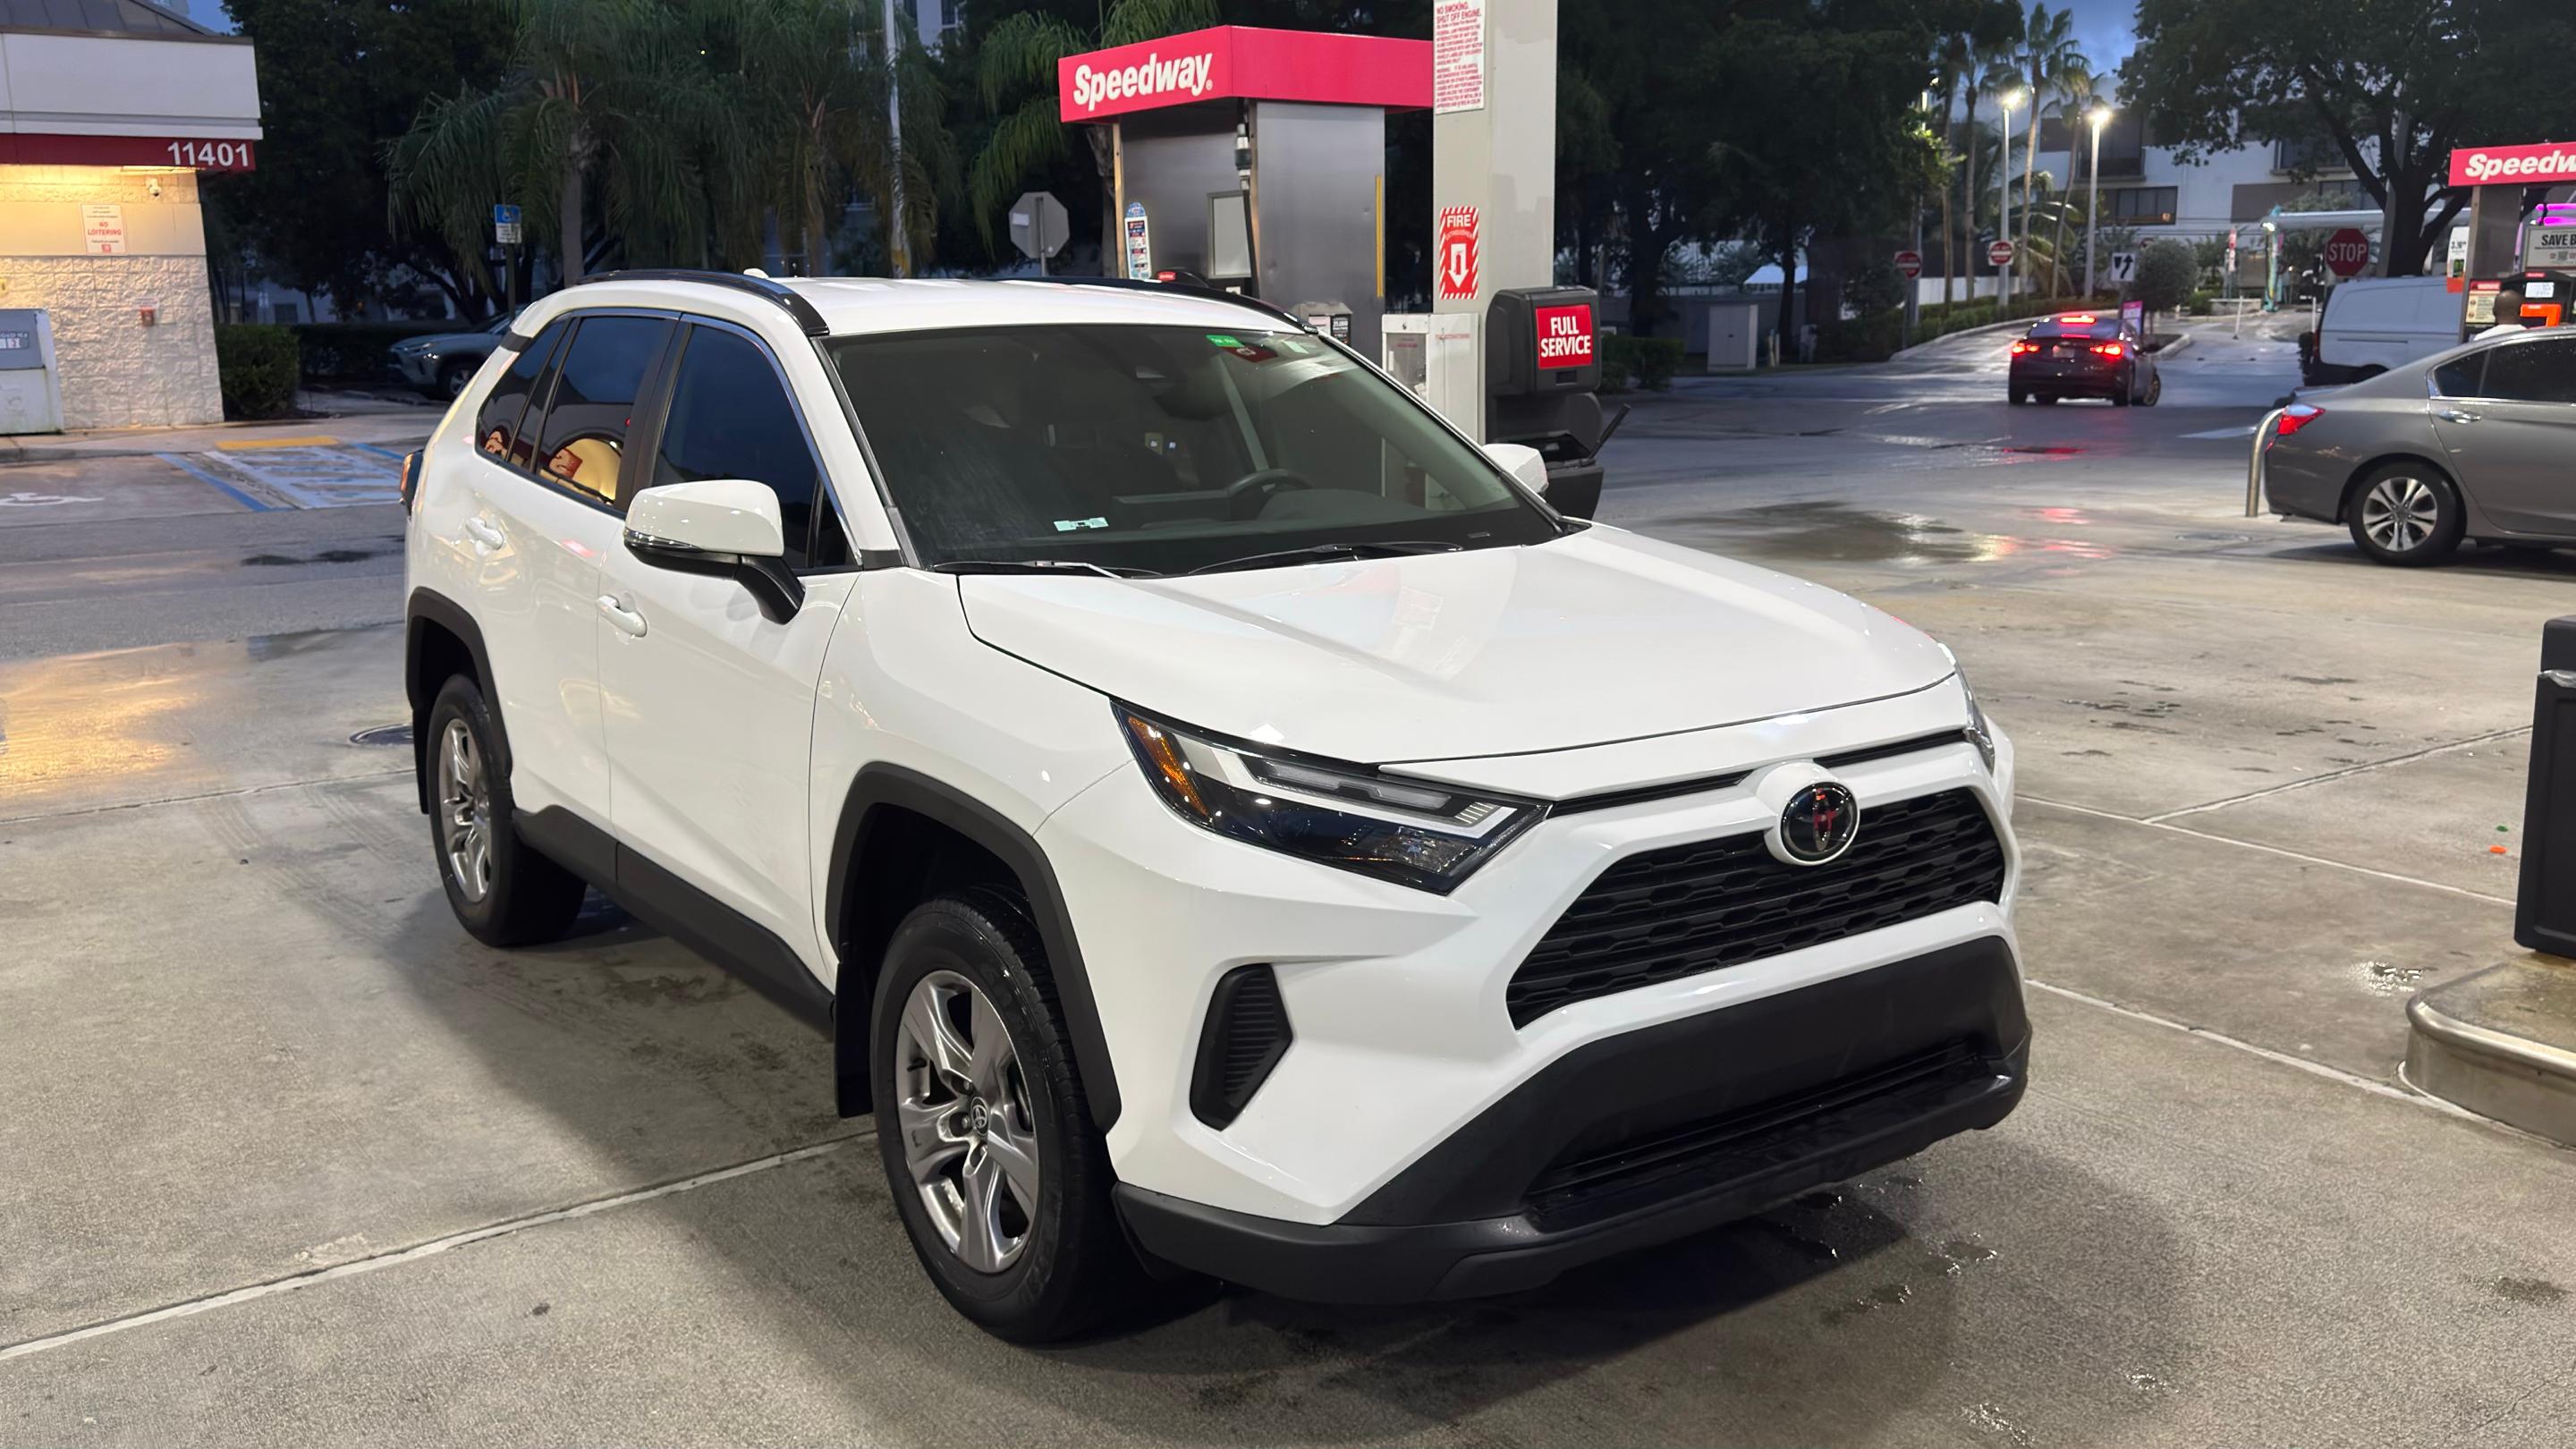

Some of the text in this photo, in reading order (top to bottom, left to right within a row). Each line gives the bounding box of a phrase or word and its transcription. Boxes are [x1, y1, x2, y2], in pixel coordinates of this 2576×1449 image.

[1451, 12, 1460, 21] OFF
[167, 141, 249, 167] 11401
[1446, 214, 1471, 228] FIRE
[87, 228, 122, 236] LOITERING
[2541, 233, 2568, 247] SAVE
[2328, 242, 2367, 262] STOP
[1550, 315, 1580, 336] FULL
[1540, 335, 1591, 358] SERVICE
